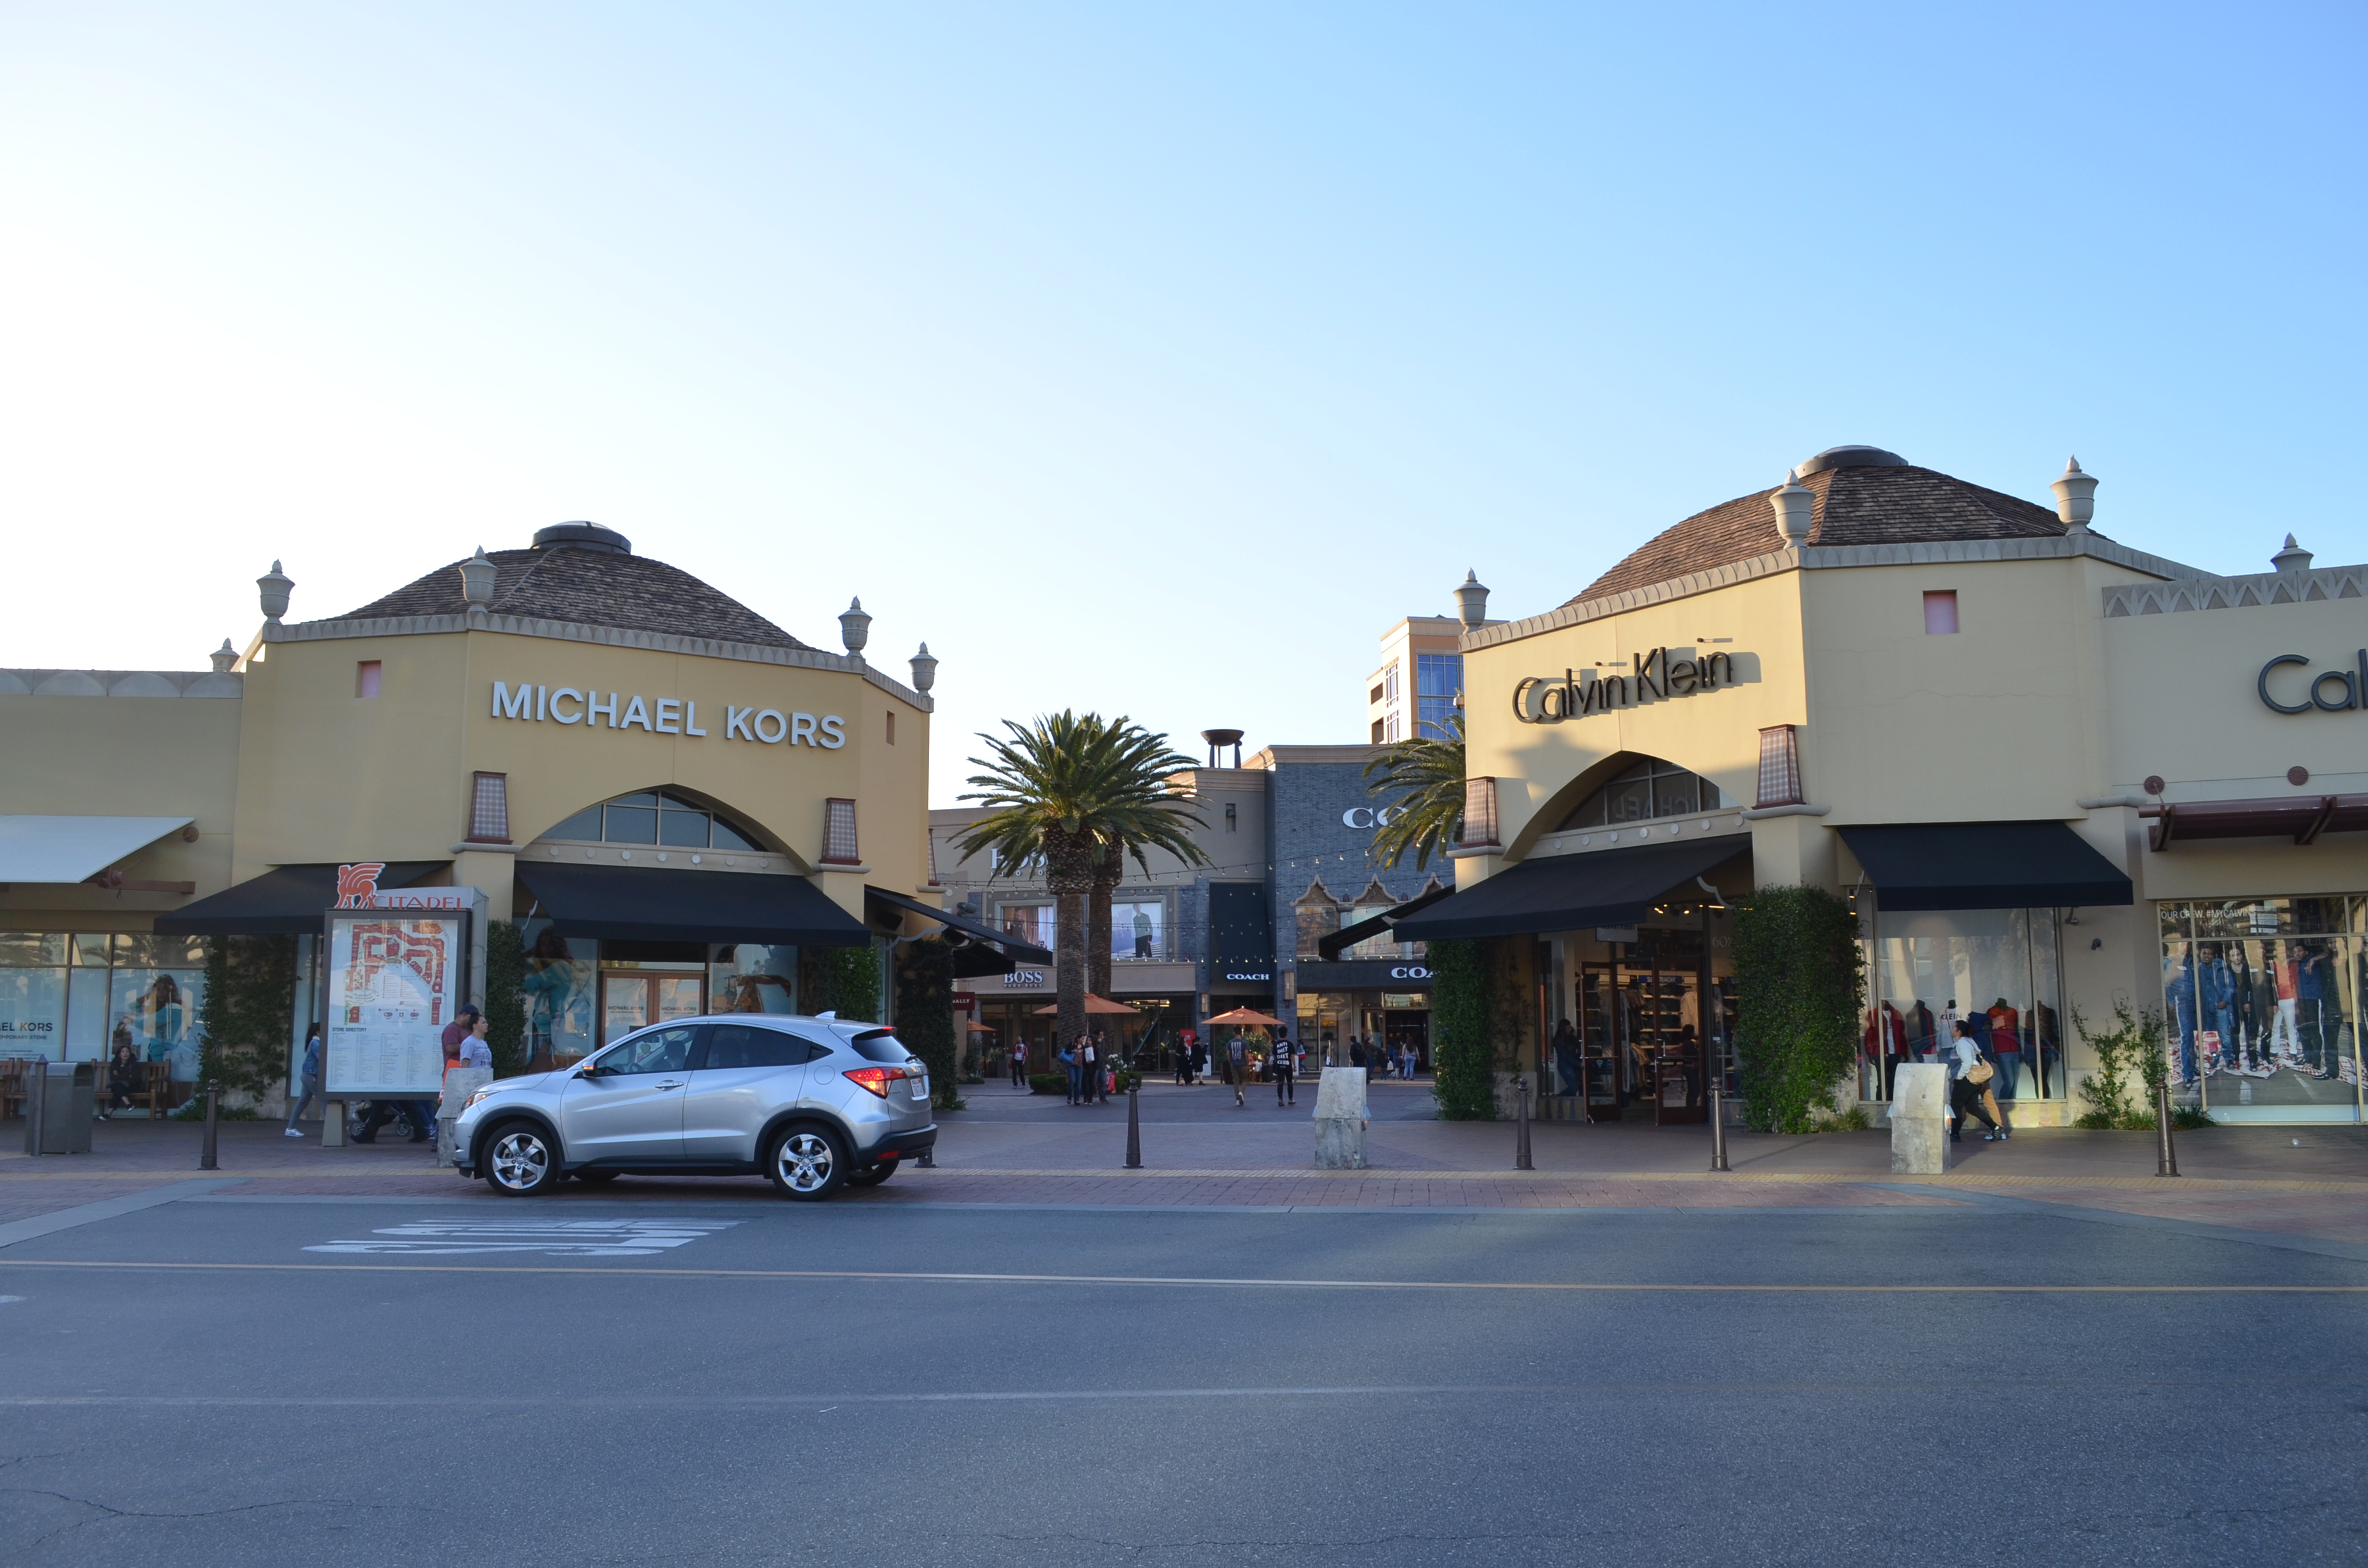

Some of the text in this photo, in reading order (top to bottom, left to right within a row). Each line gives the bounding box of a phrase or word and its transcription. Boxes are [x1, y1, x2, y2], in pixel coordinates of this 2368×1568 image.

[1513, 637, 1732, 723] Calvin Klein
[492, 681, 846, 749] MICHAEL KORS
[372, 896, 466, 910] CITADEL
[2161, 911, 2178, 919] OUR
[1004, 971, 1043, 983] BOSS
[20, 1022, 53, 1032] KORS
